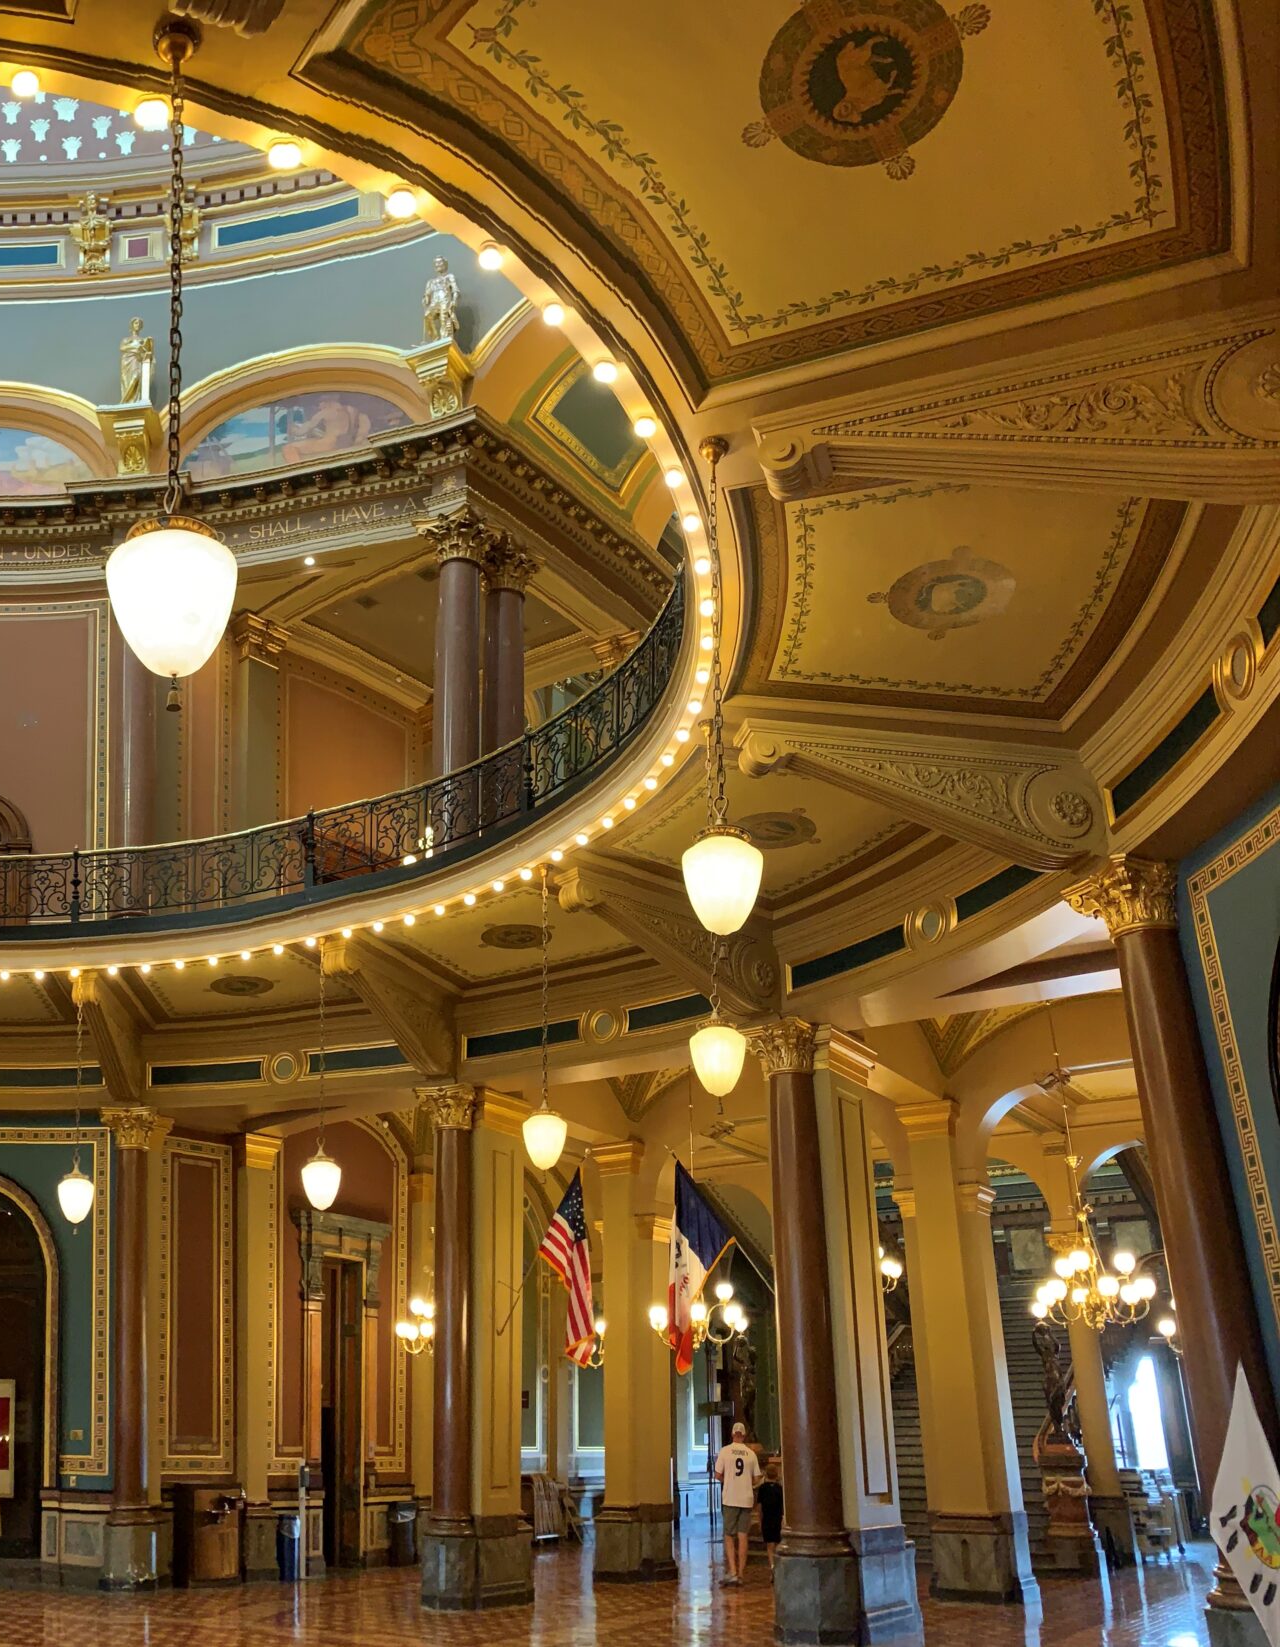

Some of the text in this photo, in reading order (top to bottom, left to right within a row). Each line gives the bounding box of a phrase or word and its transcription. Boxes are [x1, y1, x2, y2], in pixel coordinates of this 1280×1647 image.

[24, 543, 94, 560] UNDER
[249, 517, 311, 540] SHALL
[332, 502, 385, 524] HAVE
[403, 497, 417, 513] A
[735, 1457, 744, 1477] 9
